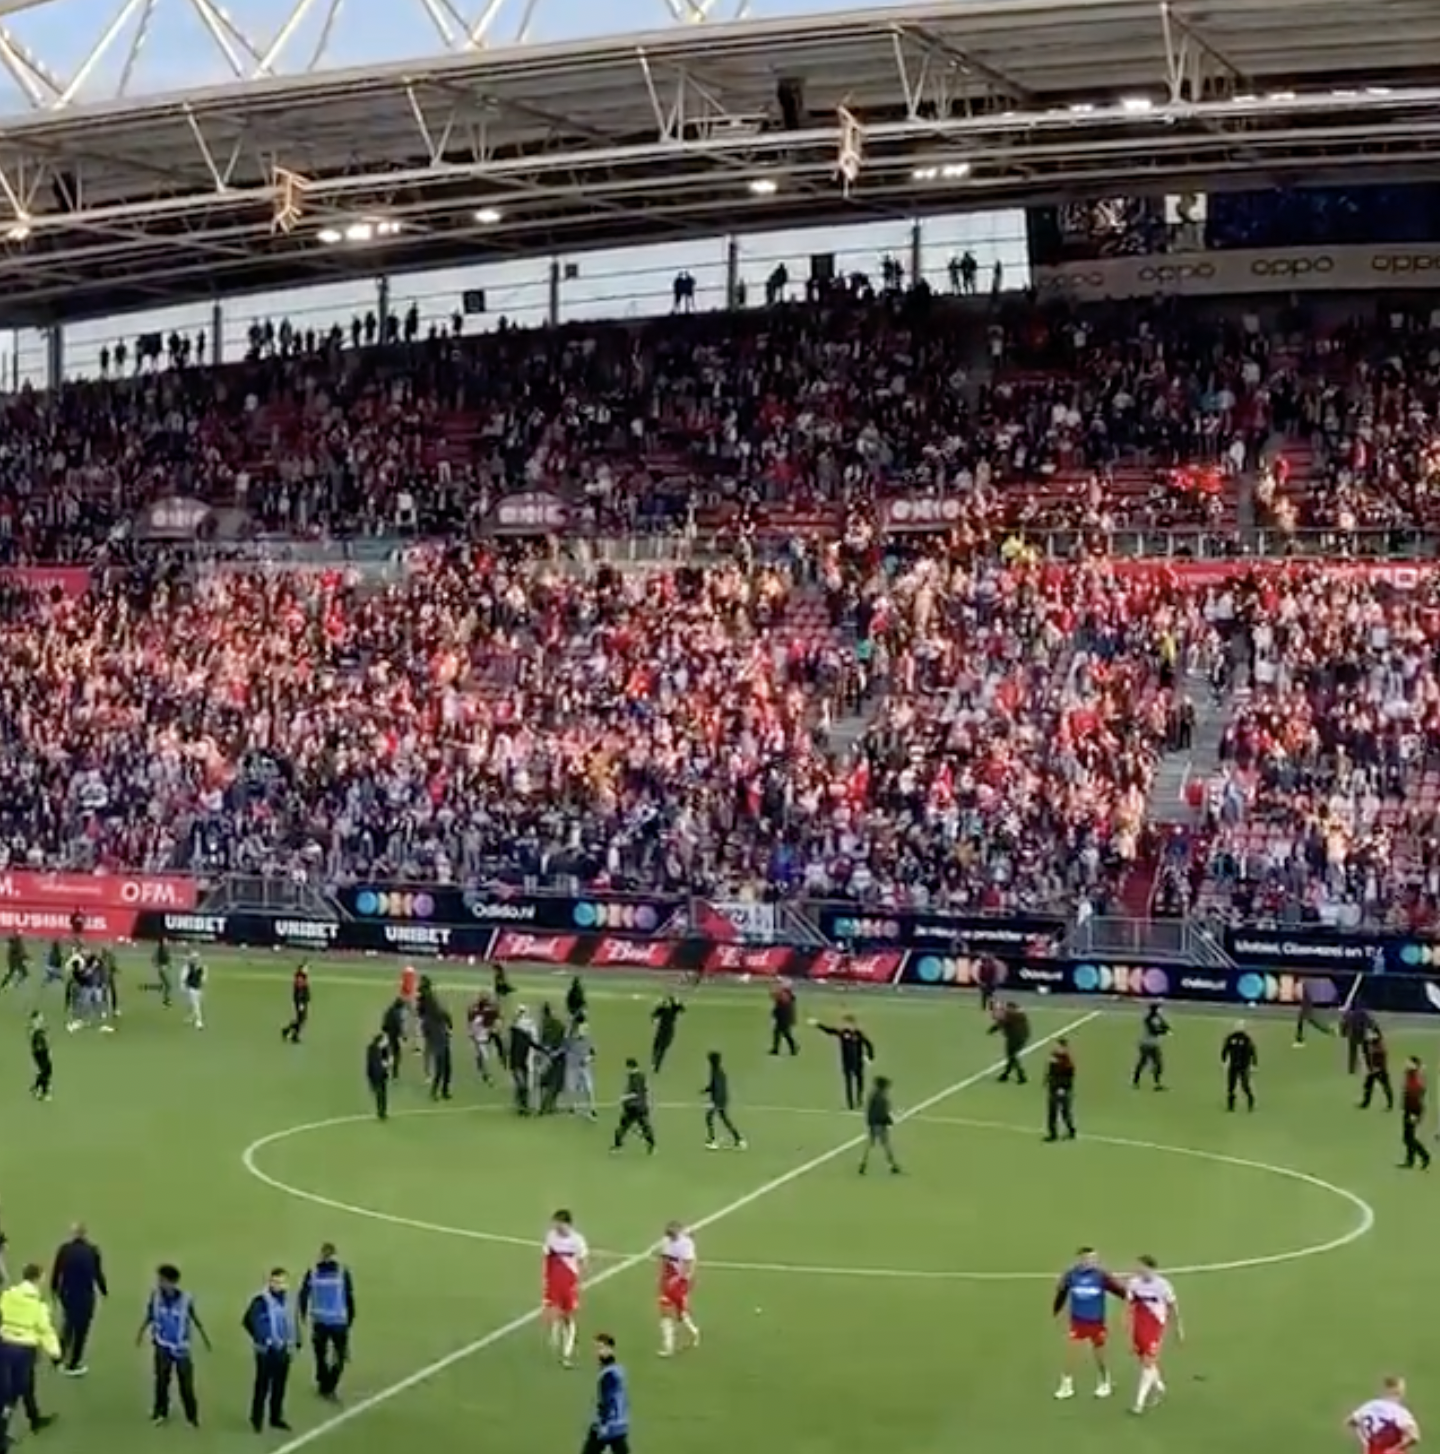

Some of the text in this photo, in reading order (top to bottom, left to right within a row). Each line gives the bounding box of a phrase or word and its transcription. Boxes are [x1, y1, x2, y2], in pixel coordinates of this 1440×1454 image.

[1251, 254, 1335, 278] oppo
[1372, 253, 1440, 275] opp
[120, 880, 185, 904] OFM.
[164, 913, 228, 934] UNIBET
[275, 918, 338, 939] UNIBET
[384, 924, 452, 945] UNIBET
